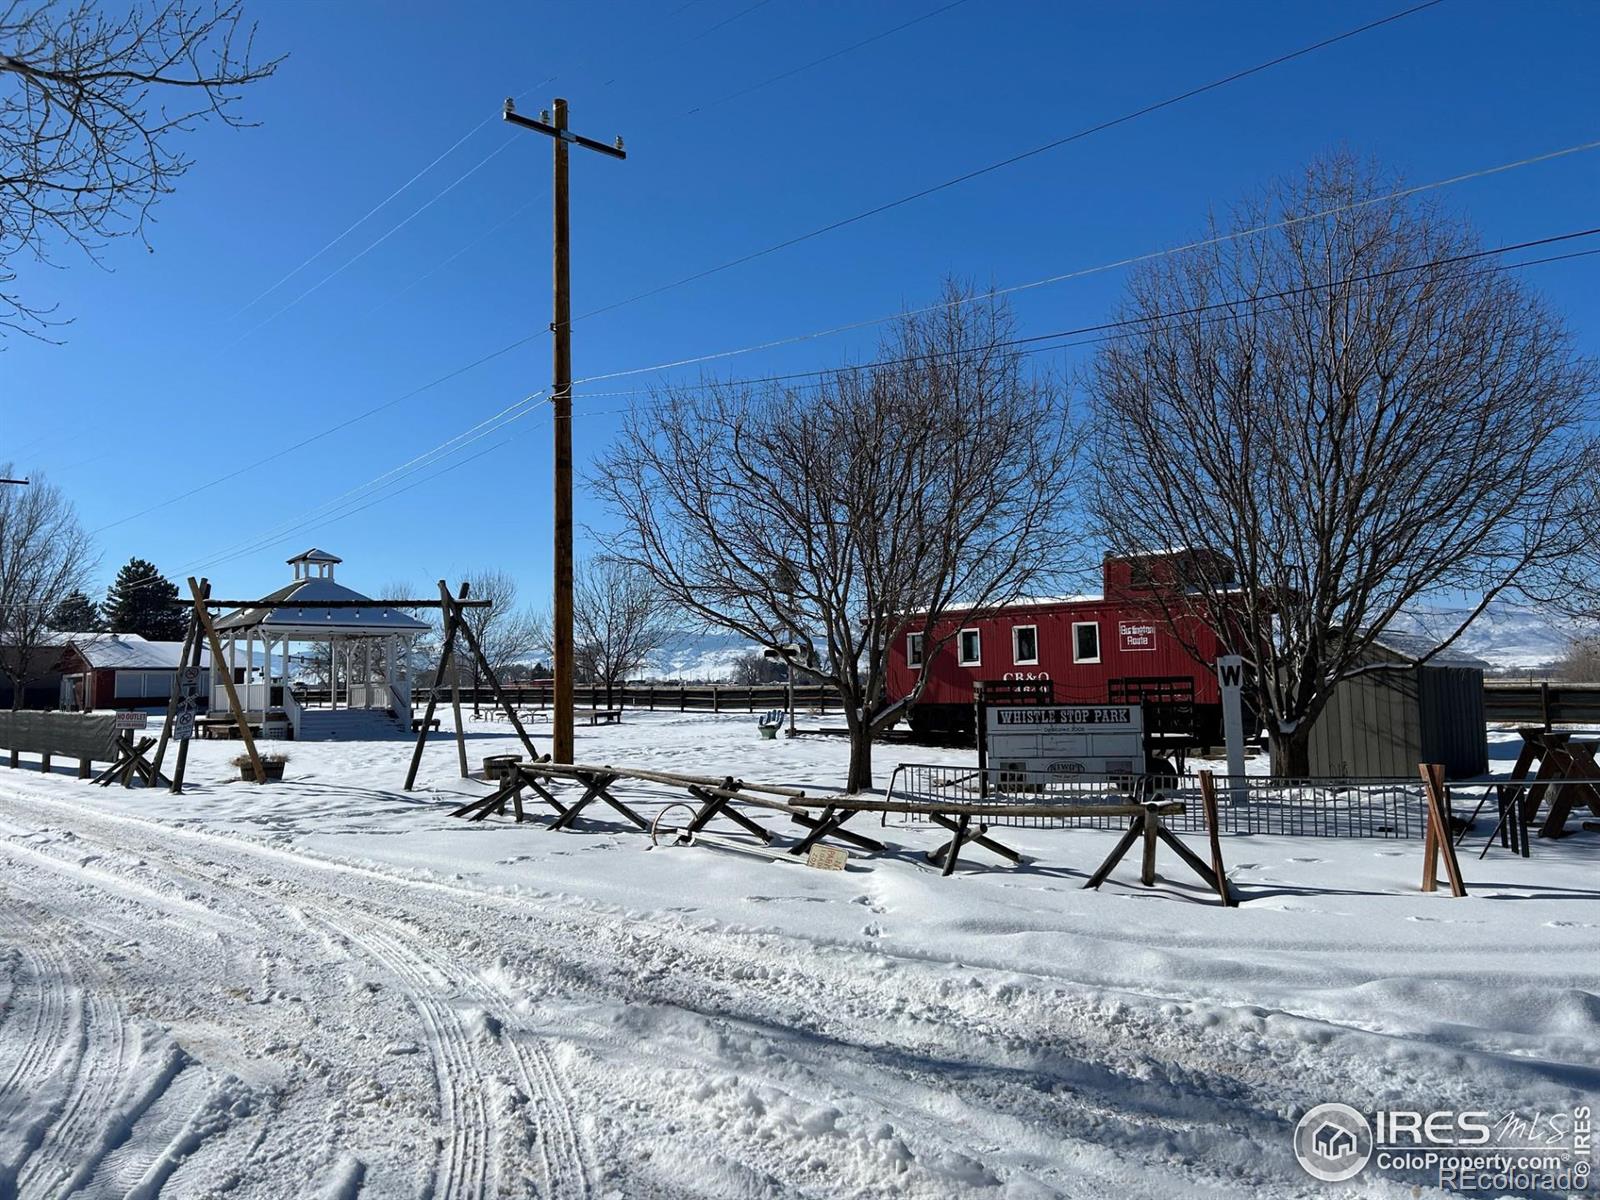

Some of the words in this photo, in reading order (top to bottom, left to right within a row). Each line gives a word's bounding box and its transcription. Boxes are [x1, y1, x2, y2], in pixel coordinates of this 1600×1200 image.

[1120, 625, 1153, 634] Burlington
[1127, 636, 1148, 645] Route
[1220, 665, 1241, 686] W
[1000, 709, 1056, 723] WHISTLE
[1060, 709, 1089, 723] STOP
[1094, 708, 1128, 722] PARK
